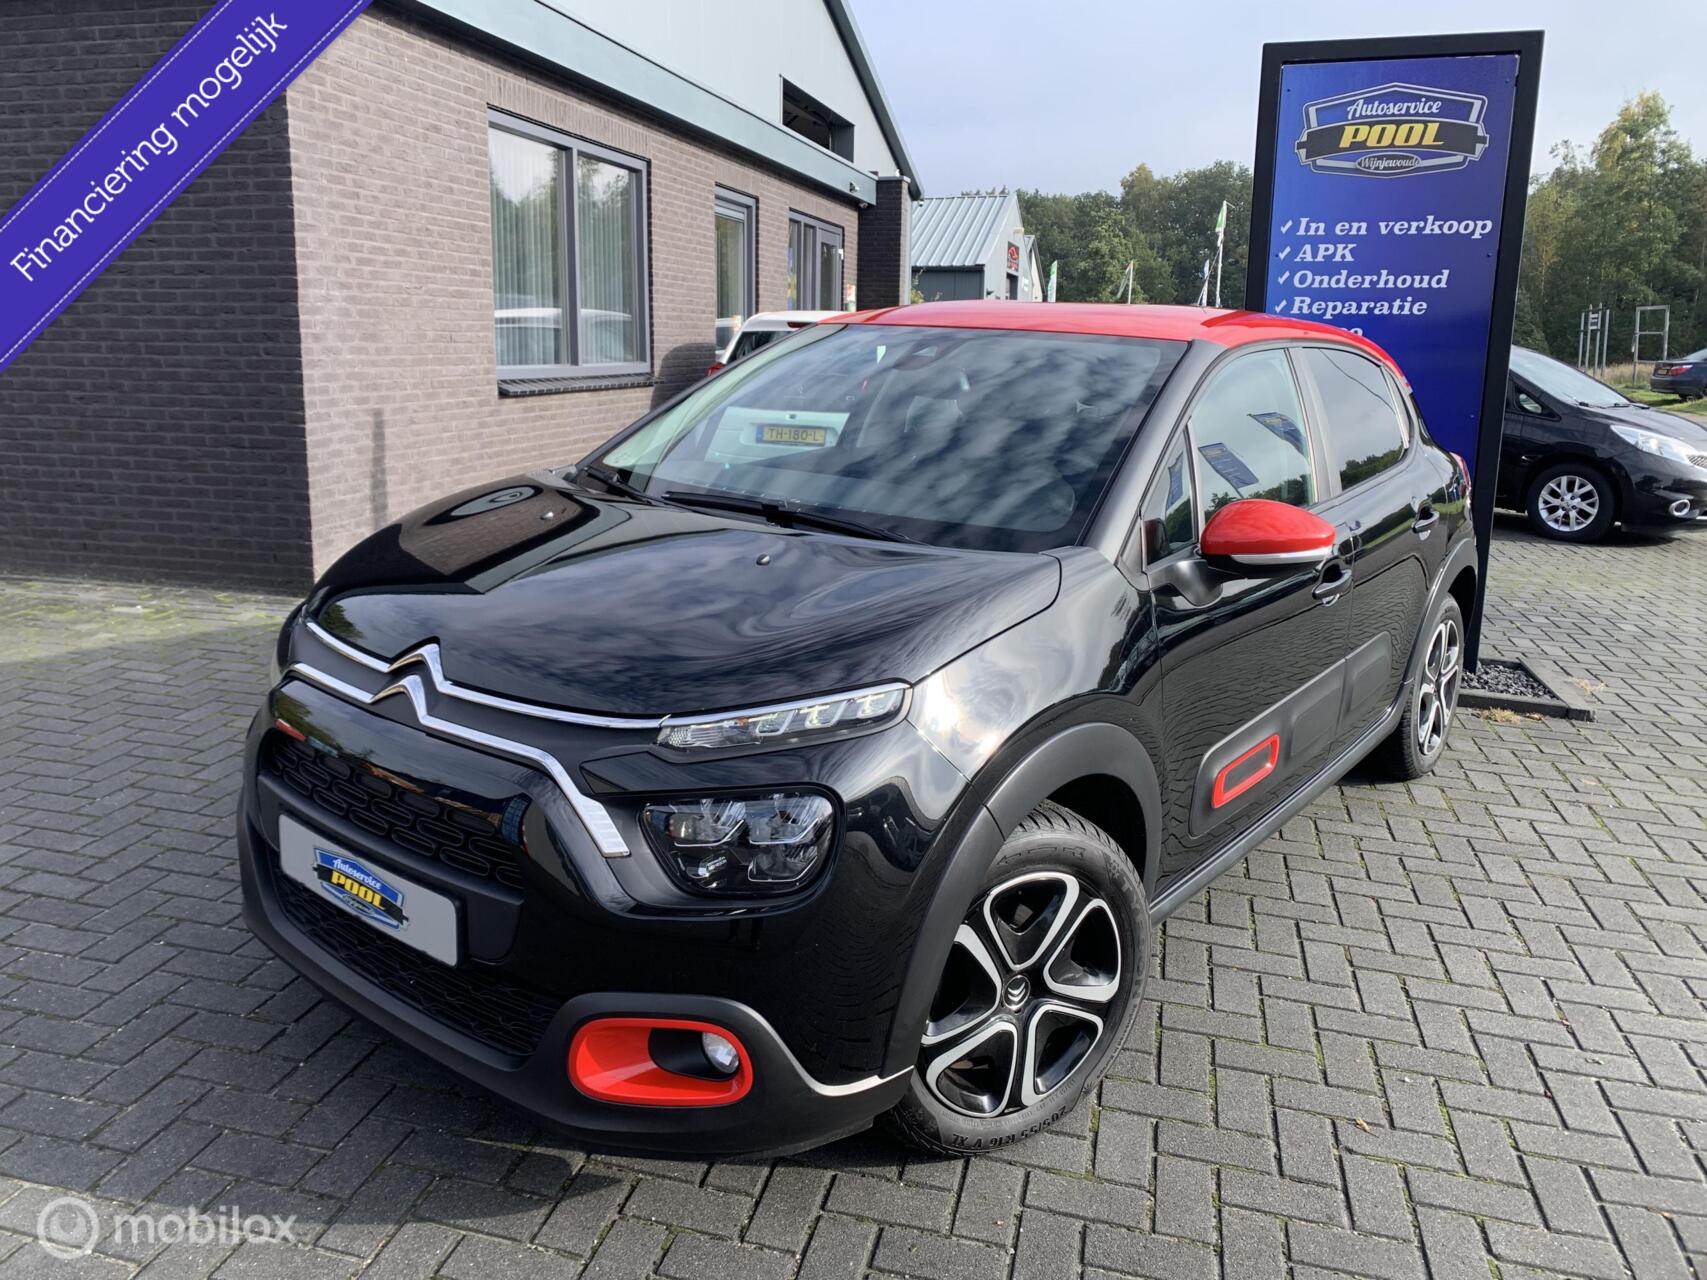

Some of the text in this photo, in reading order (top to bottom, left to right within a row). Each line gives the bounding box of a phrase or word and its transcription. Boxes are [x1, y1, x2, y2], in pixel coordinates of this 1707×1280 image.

[1347, 98, 1442, 120] Autoservice
[1339, 122, 1445, 148] POOL
[1296, 215, 1493, 239] In en verkoop
[1294, 244, 1357, 263] APK
[1293, 269, 1450, 289] Onderhoud
[1290, 296, 1428, 319] Reparatie
[768, 428, 819, 441] TH-180-L
[332, 858, 383, 890] Autoservice
[331, 870, 385, 910] POOL
[1021, 1106, 1066, 1138] 205/55
